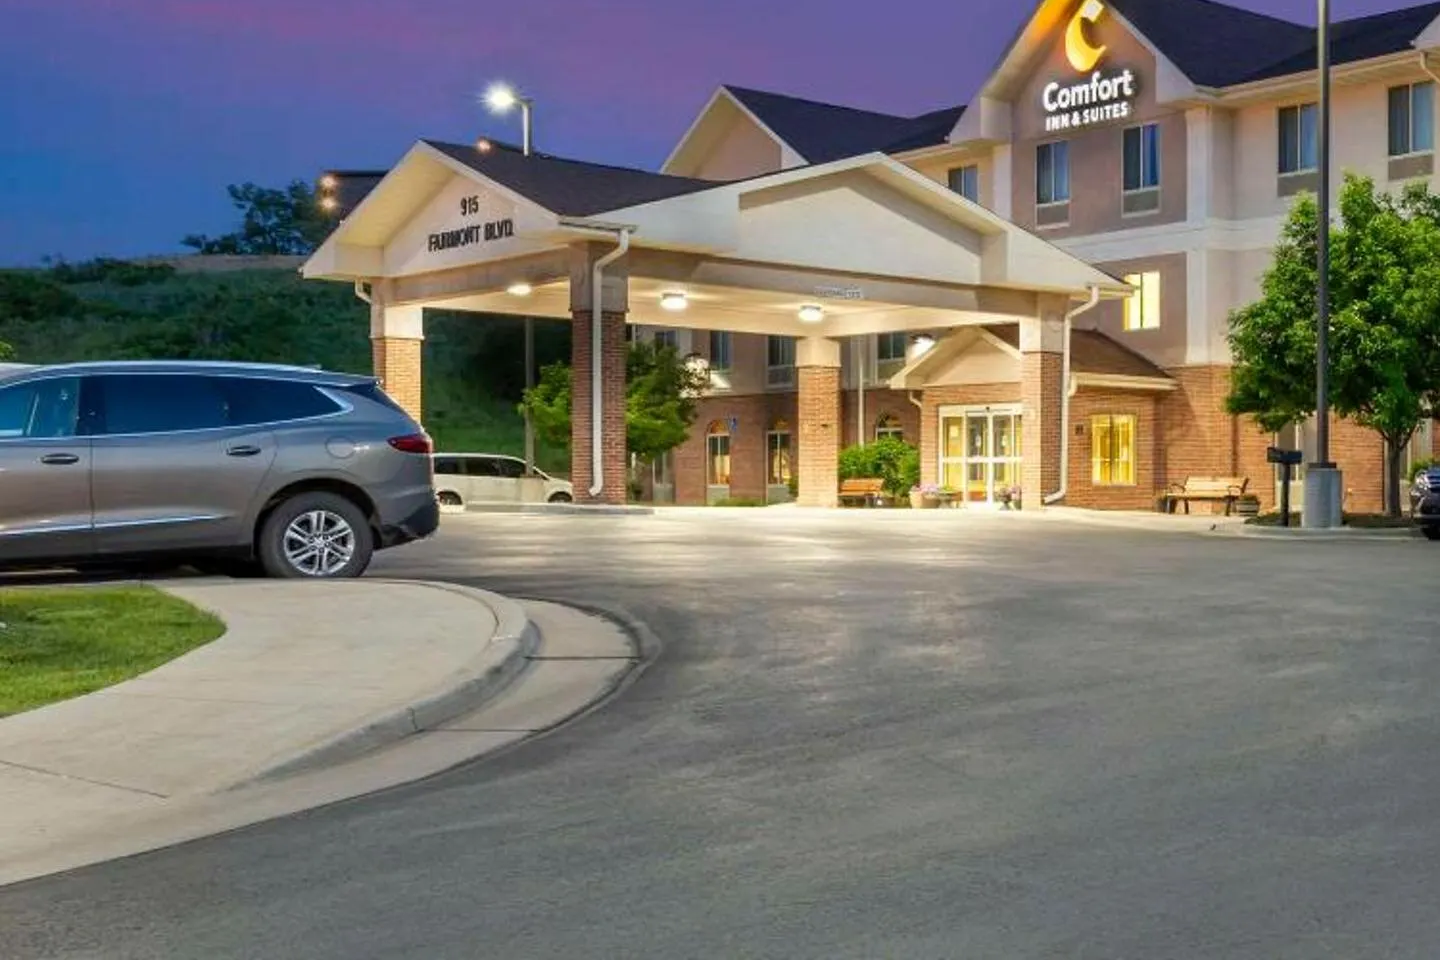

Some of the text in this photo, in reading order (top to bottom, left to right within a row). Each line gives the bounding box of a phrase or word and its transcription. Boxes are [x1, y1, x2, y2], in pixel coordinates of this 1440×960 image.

[1043, 69, 1134, 112] Comfort
[1045, 113, 1070, 131] INN
[1082, 101, 1129, 124] SUITES
[460, 195, 479, 216] 915
[427, 225, 481, 252] FAIRMONT
